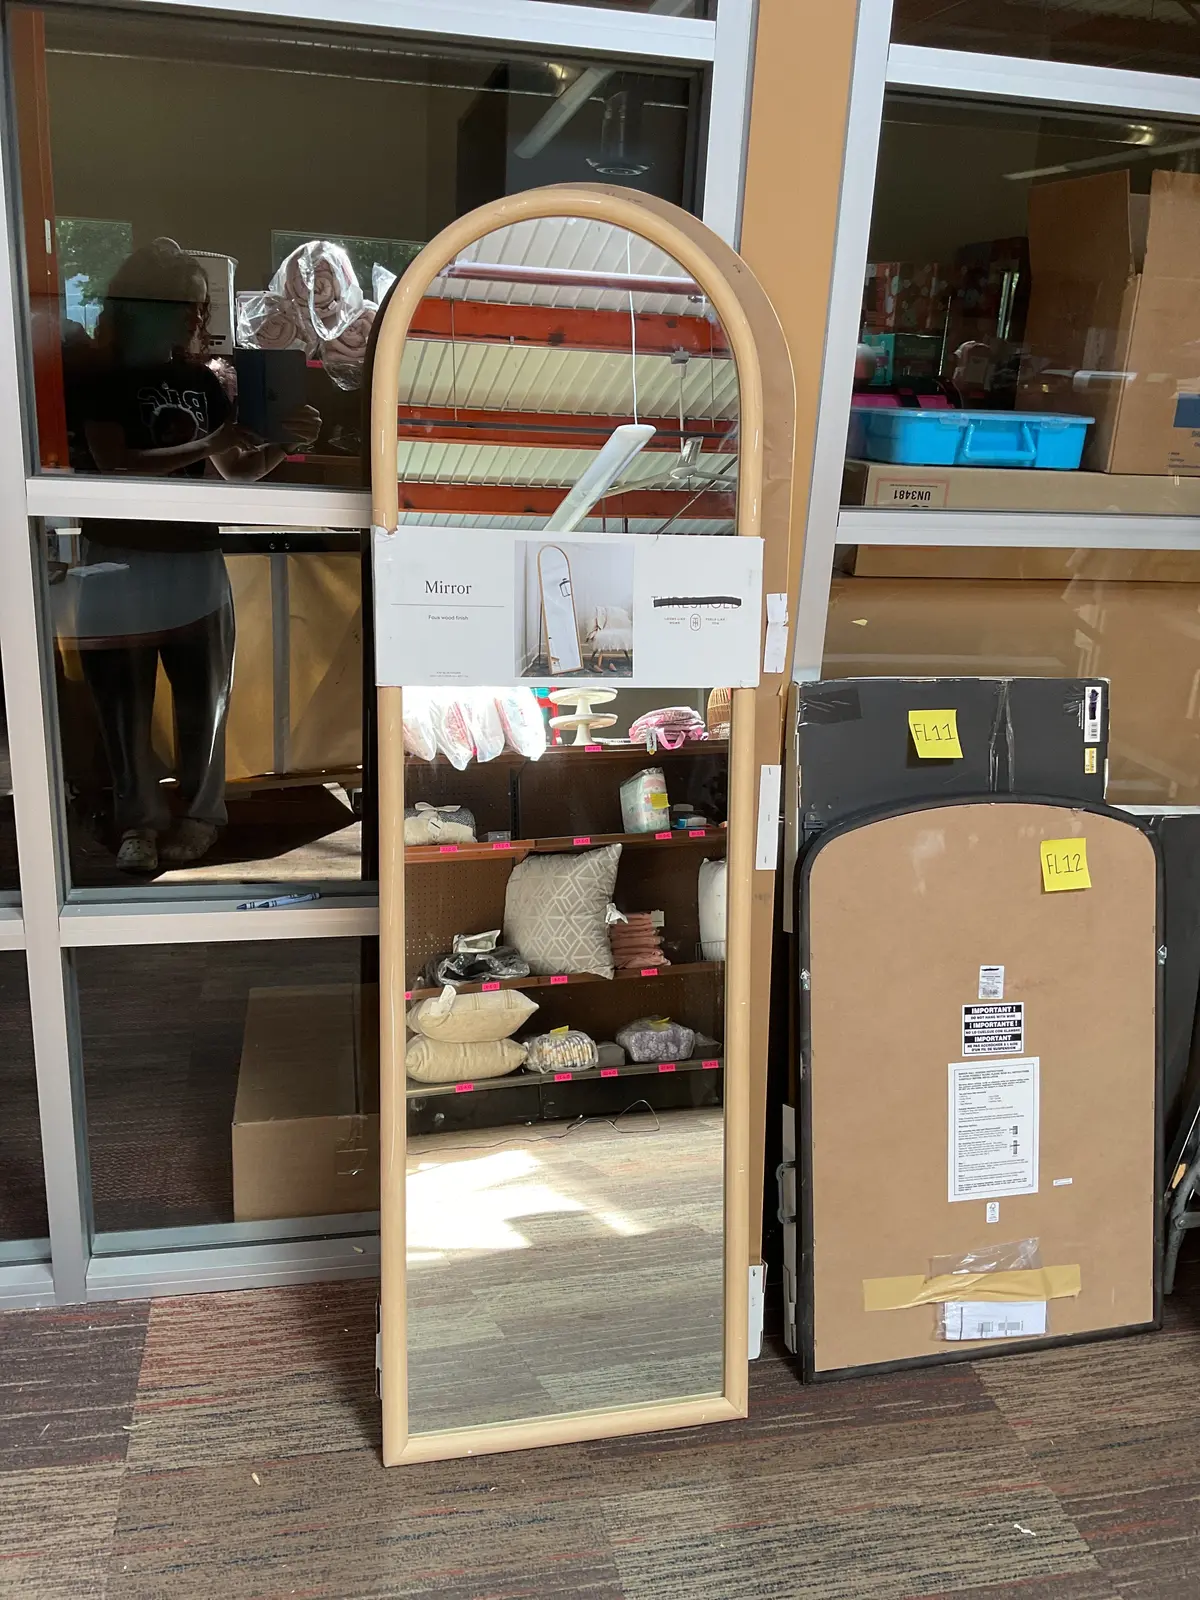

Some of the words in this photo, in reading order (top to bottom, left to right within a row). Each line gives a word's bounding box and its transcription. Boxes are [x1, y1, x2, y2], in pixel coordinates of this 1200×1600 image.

[893, 490, 931, 501] UN3481
[425, 580, 472, 594] Mirror
[913, 723, 956, 742] FL11
[1046, 853, 1083, 875] FL12
[971, 1006, 1012, 1014] IMPORTANT
